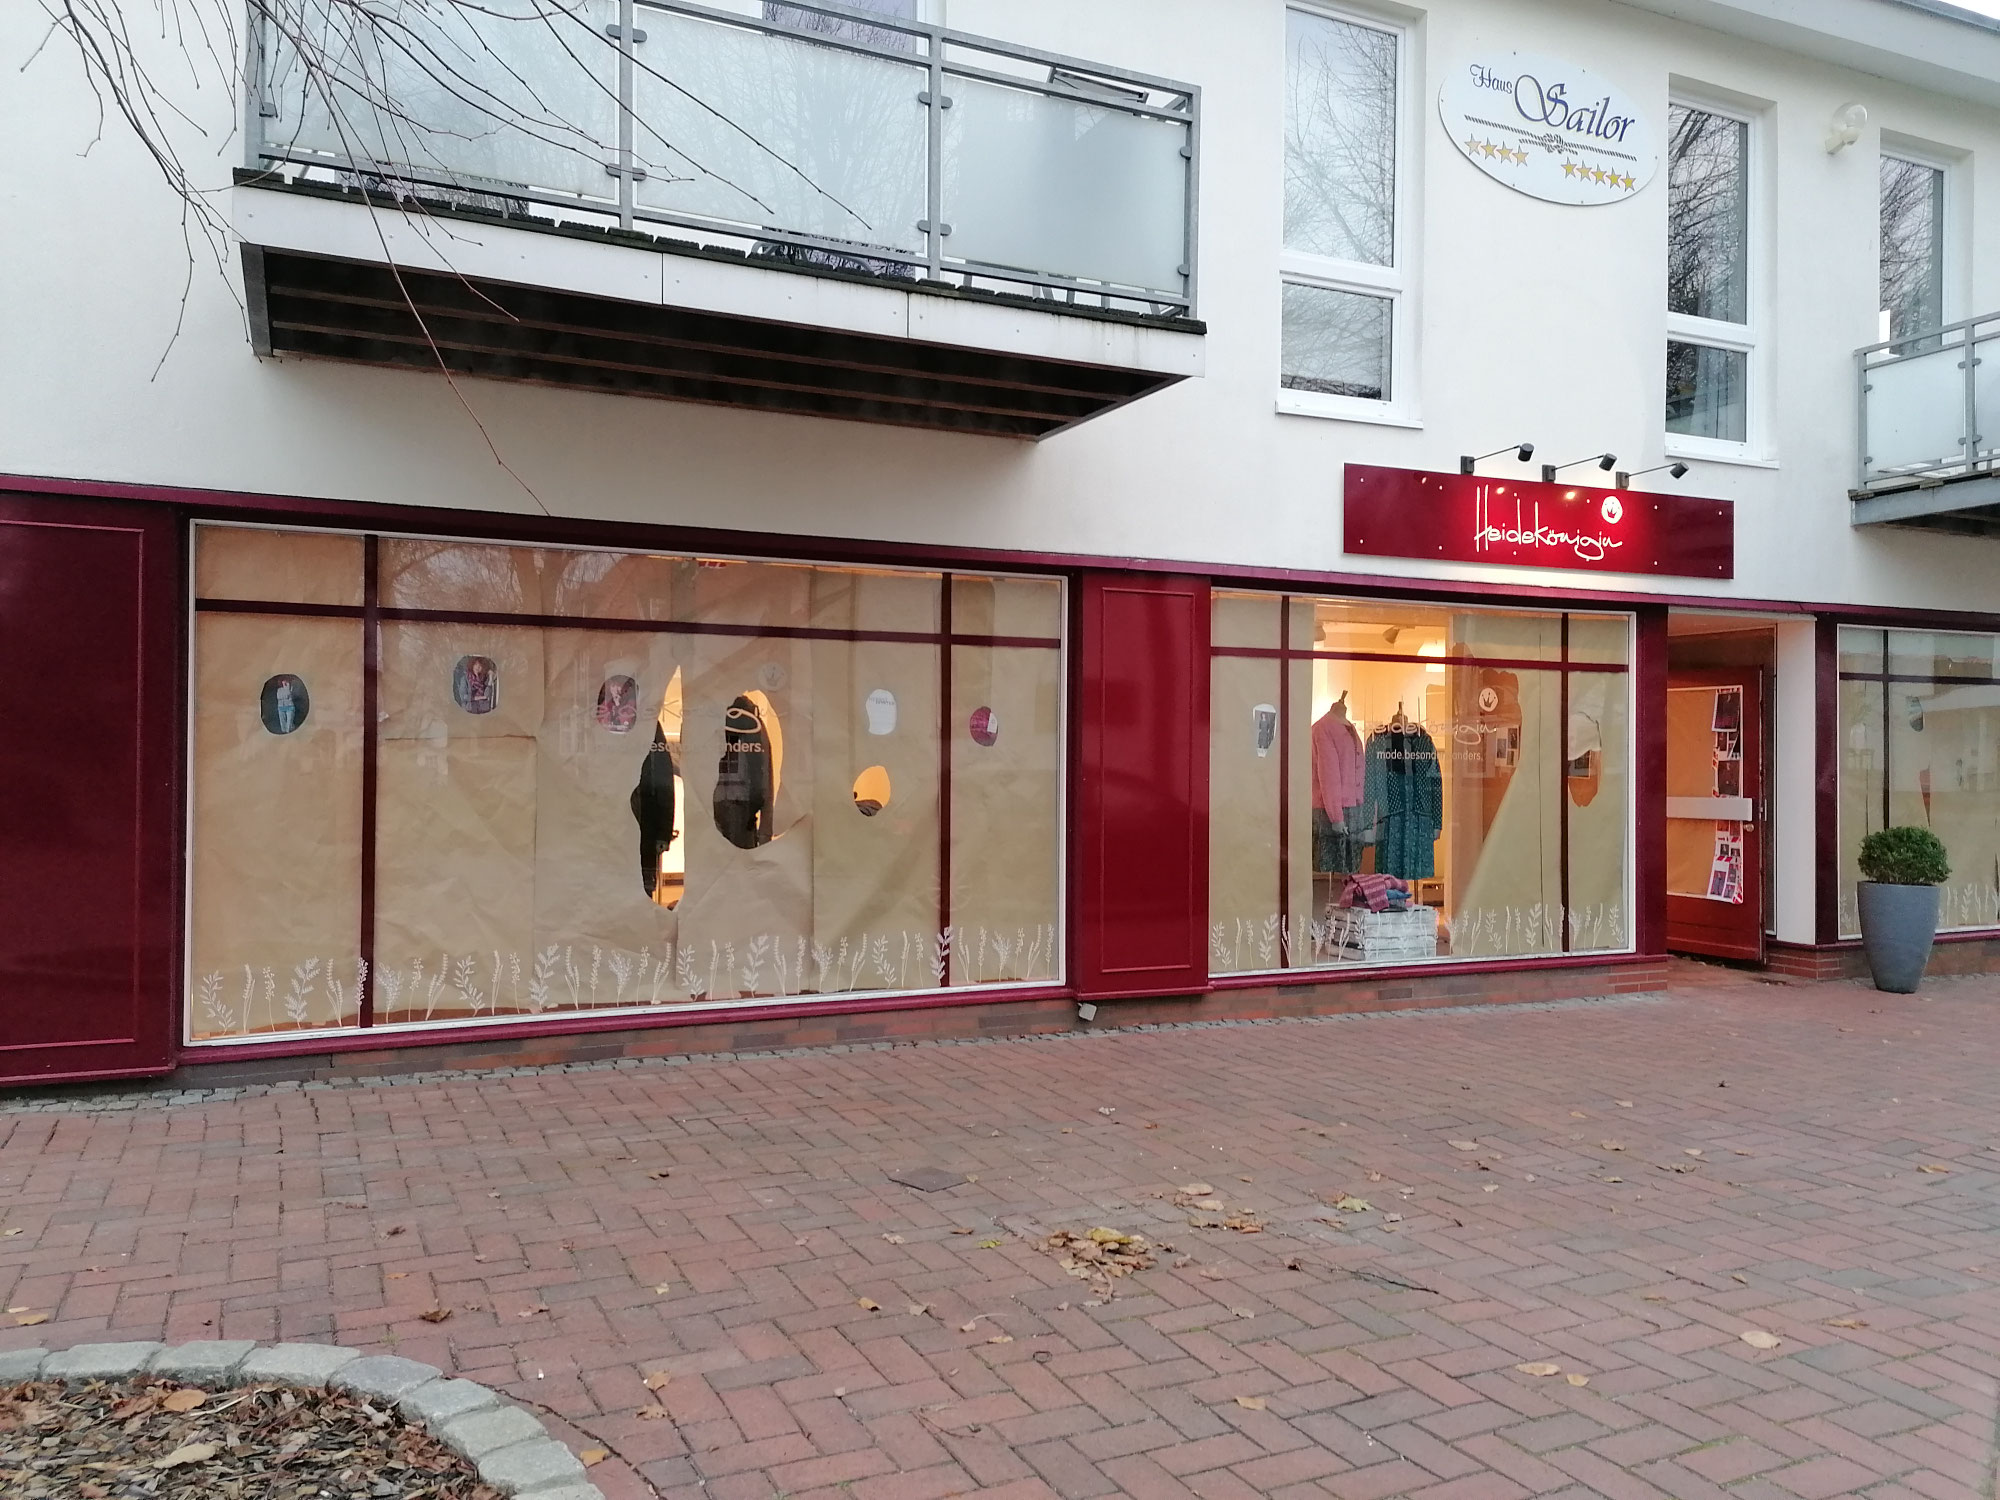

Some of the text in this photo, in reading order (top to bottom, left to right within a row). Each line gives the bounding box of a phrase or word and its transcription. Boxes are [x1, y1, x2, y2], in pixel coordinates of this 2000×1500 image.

[1470, 63, 1636, 143] Haus Sailor
[1474, 484, 1623, 561] Heidekönigin
